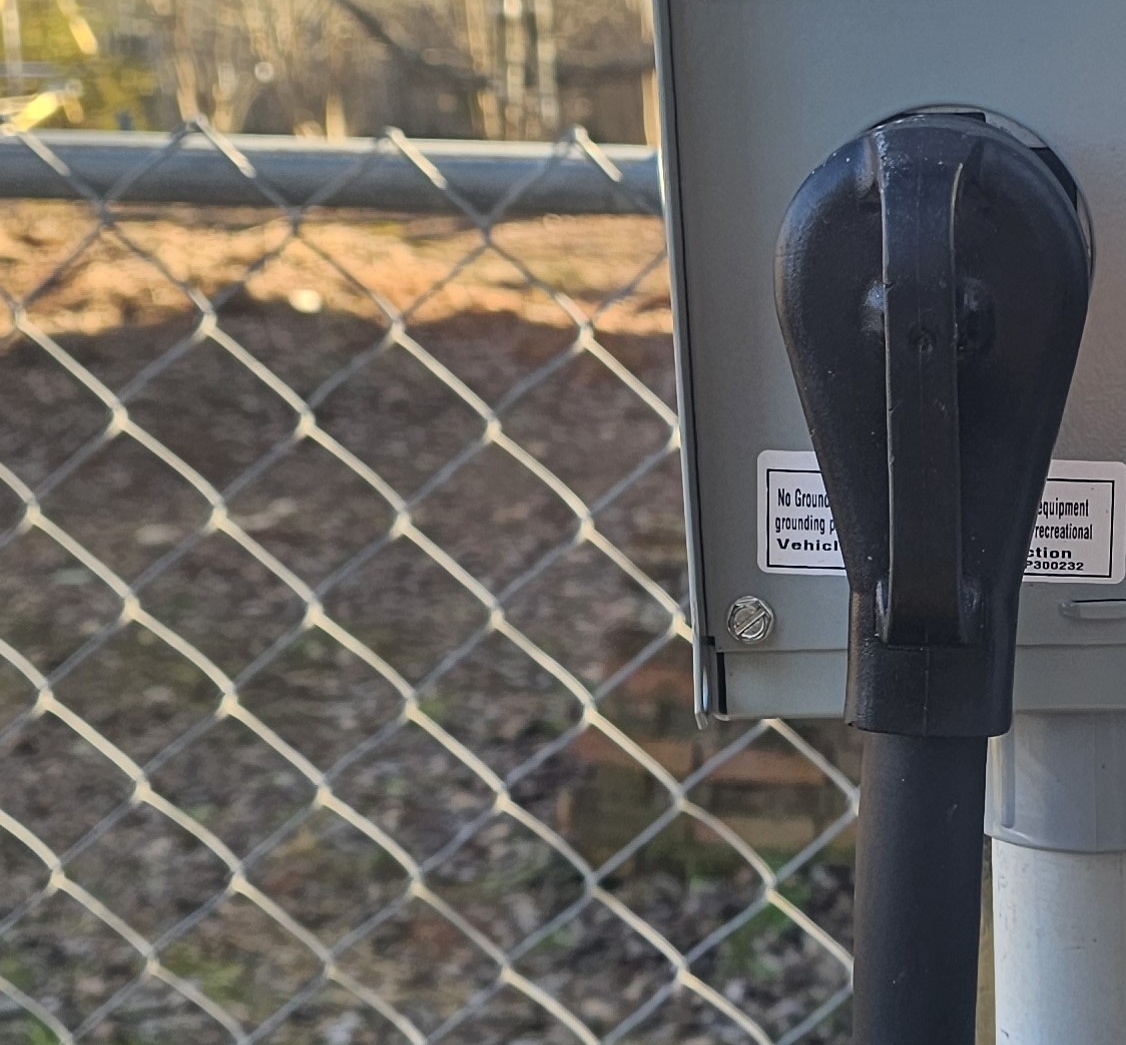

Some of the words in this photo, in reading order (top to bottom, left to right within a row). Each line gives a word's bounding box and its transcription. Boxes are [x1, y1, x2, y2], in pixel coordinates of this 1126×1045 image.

[778, 488, 791, 507] No
[775, 514, 825, 535] grounding
[1034, 523, 1093, 540] recreational
